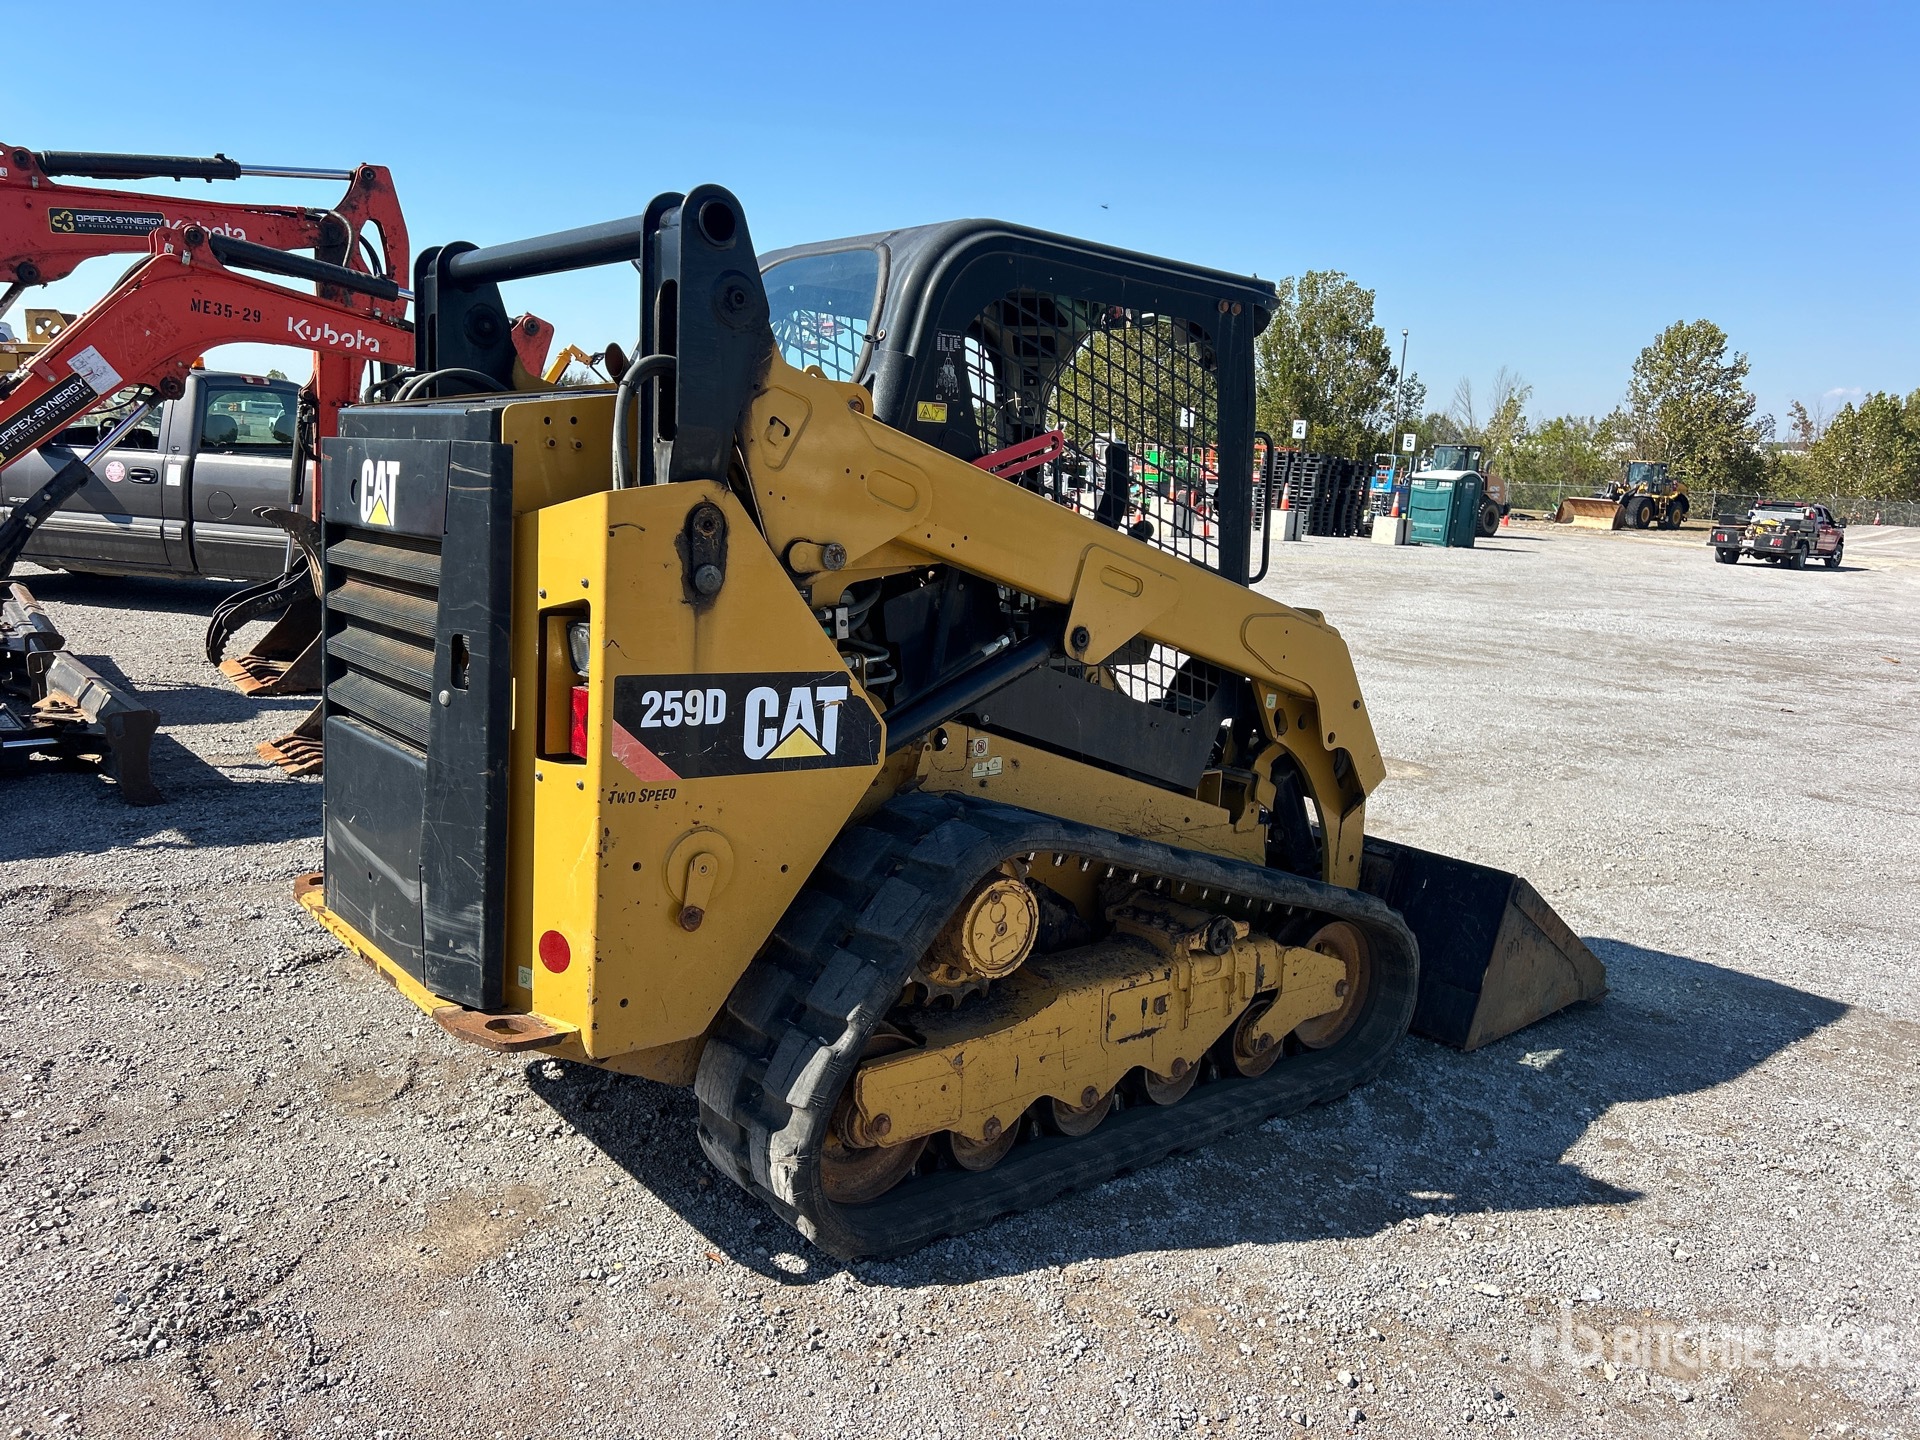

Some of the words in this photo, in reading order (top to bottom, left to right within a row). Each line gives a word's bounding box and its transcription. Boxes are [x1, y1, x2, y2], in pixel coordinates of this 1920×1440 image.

[76, 214, 164, 226] OPIFEX-SYNERGY
[190, 297, 262, 324] ME35-29
[287, 316, 380, 353] Kubota
[14, 421, 46, 443] BUILDERS
[46, 410, 60, 421] FOR
[61, 388, 91, 411] BUILDERS
[1296, 426, 1303, 435] 4
[1406, 439, 1413, 448] 5
[361, 459, 400, 527] CAT
[640, 688, 727, 728] 259D
[743, 685, 848, 760] CAT
